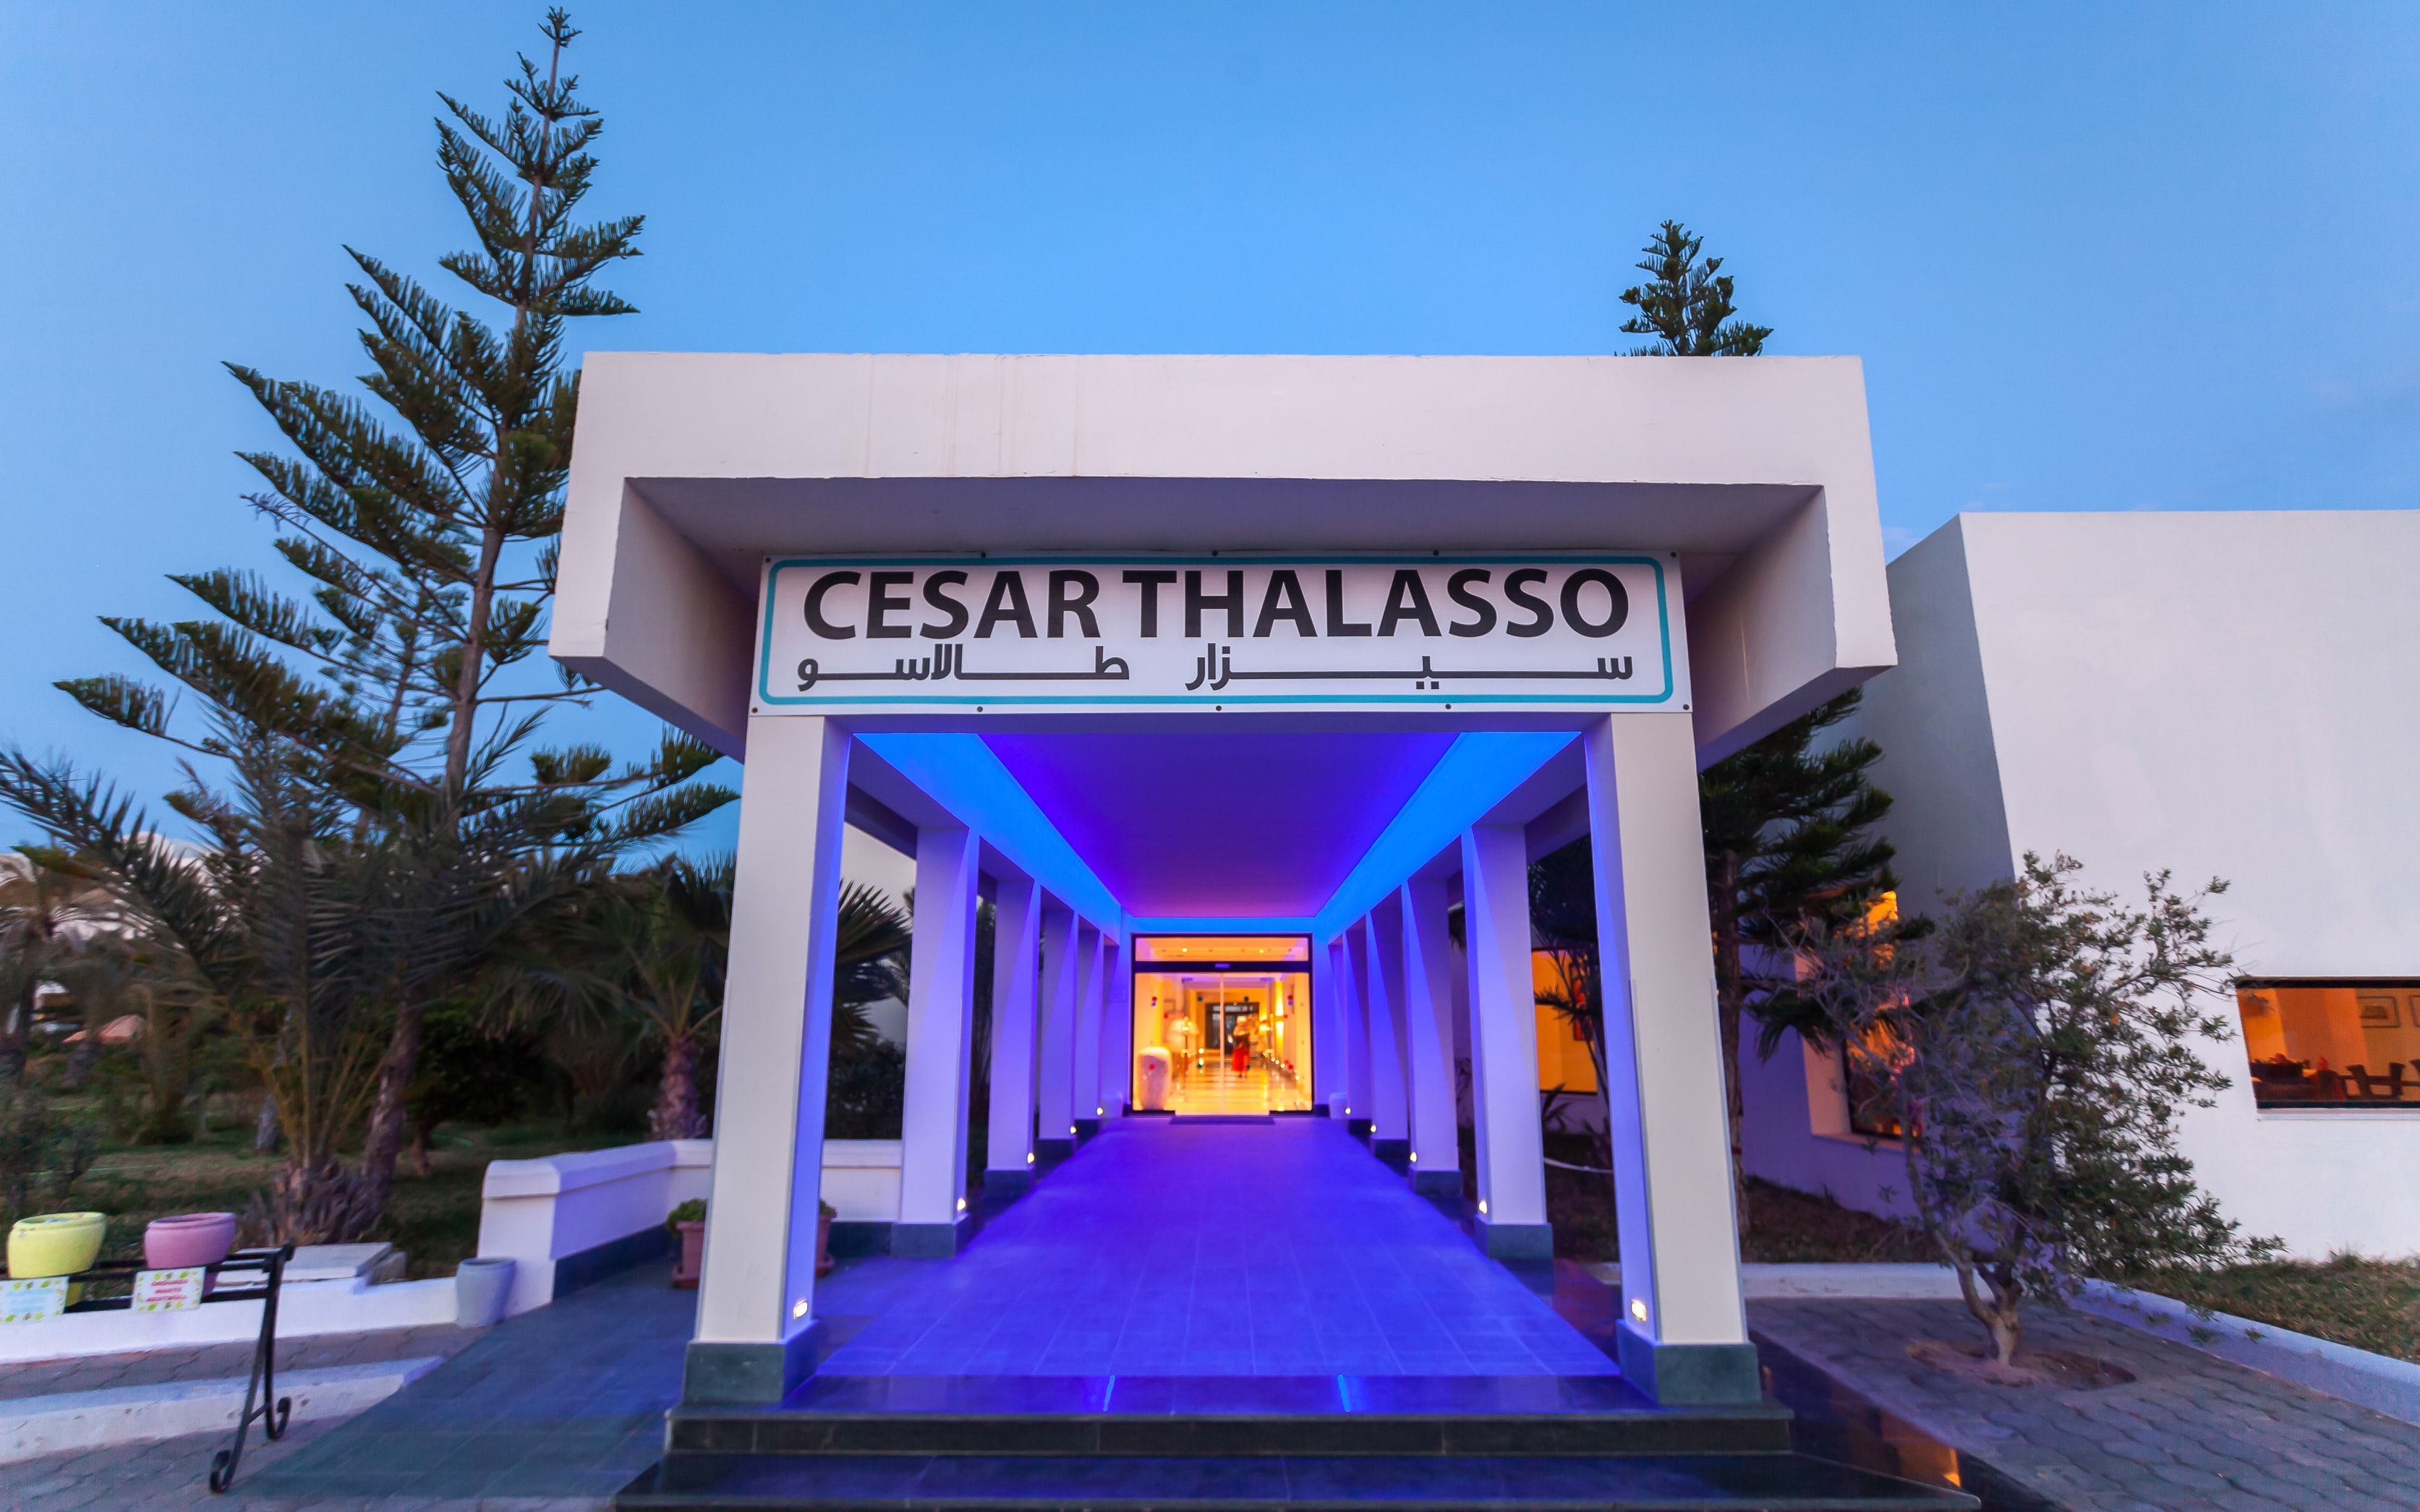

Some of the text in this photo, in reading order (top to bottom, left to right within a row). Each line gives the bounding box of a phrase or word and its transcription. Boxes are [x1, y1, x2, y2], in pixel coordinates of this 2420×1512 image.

[803, 568, 1630, 641] CESAR THALASSO
[797, 642, 1634, 693] سيزار طالاسو
